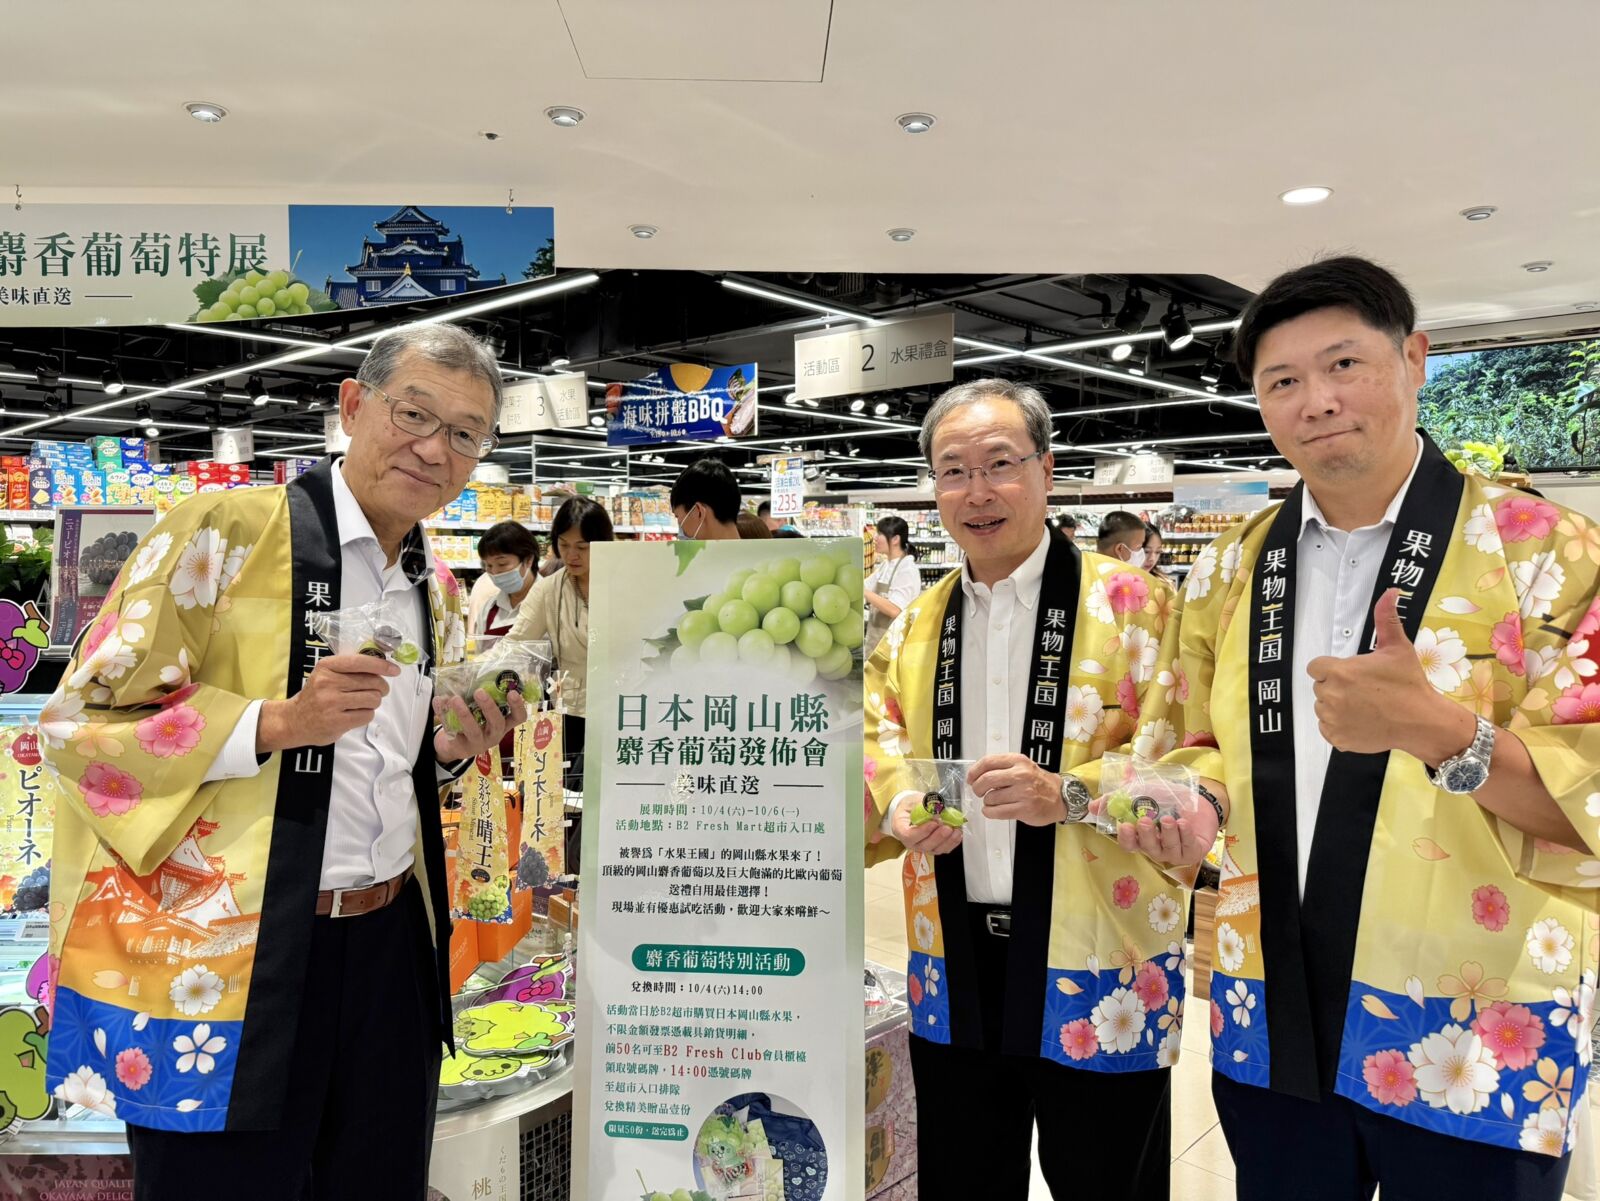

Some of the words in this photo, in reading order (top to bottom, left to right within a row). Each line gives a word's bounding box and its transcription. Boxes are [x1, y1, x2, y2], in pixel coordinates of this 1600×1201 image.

[803, 357, 840, 377] 活動區
[861, 344, 875, 372] 2
[890, 339, 948, 364] 水果禮盒
[536, 396, 545, 416] 3
[622, 394, 728, 429] 海味拼盤BBQ
[1129, 464, 1136, 477] 3
[777, 493, 797, 512] 235
[1258, 547, 1287, 664] 果物王国
[937, 614, 957, 707] 果物王国
[1034, 608, 1066, 706] 果物王国
[616, 692, 829, 733] 日本岡山縣
[1258, 678, 1282, 734] 岡山
[616, 736, 829, 767] 麝香葡萄發佈會
[1029, 719, 1055, 766] 岡山
[677, 774, 760, 796] 美味直送
[16, 765, 42, 866] ピオーネ
[696, 821, 729, 832] Fresh
[474, 818, 494, 868] 晴王
[668, 883, 769, 898] 送禮自用最佳選擇！
[645, 949, 791, 972] 麝香葡萄特別活動
[686, 1045, 724, 1060] Fresh
[604, 1081, 681, 1096] 至超市入口排隊
[39, 1191, 94, 1201] OKAYAMA
[54, 1179, 88, 1189] JAPAN
[472, 1176, 492, 1200] 桃
